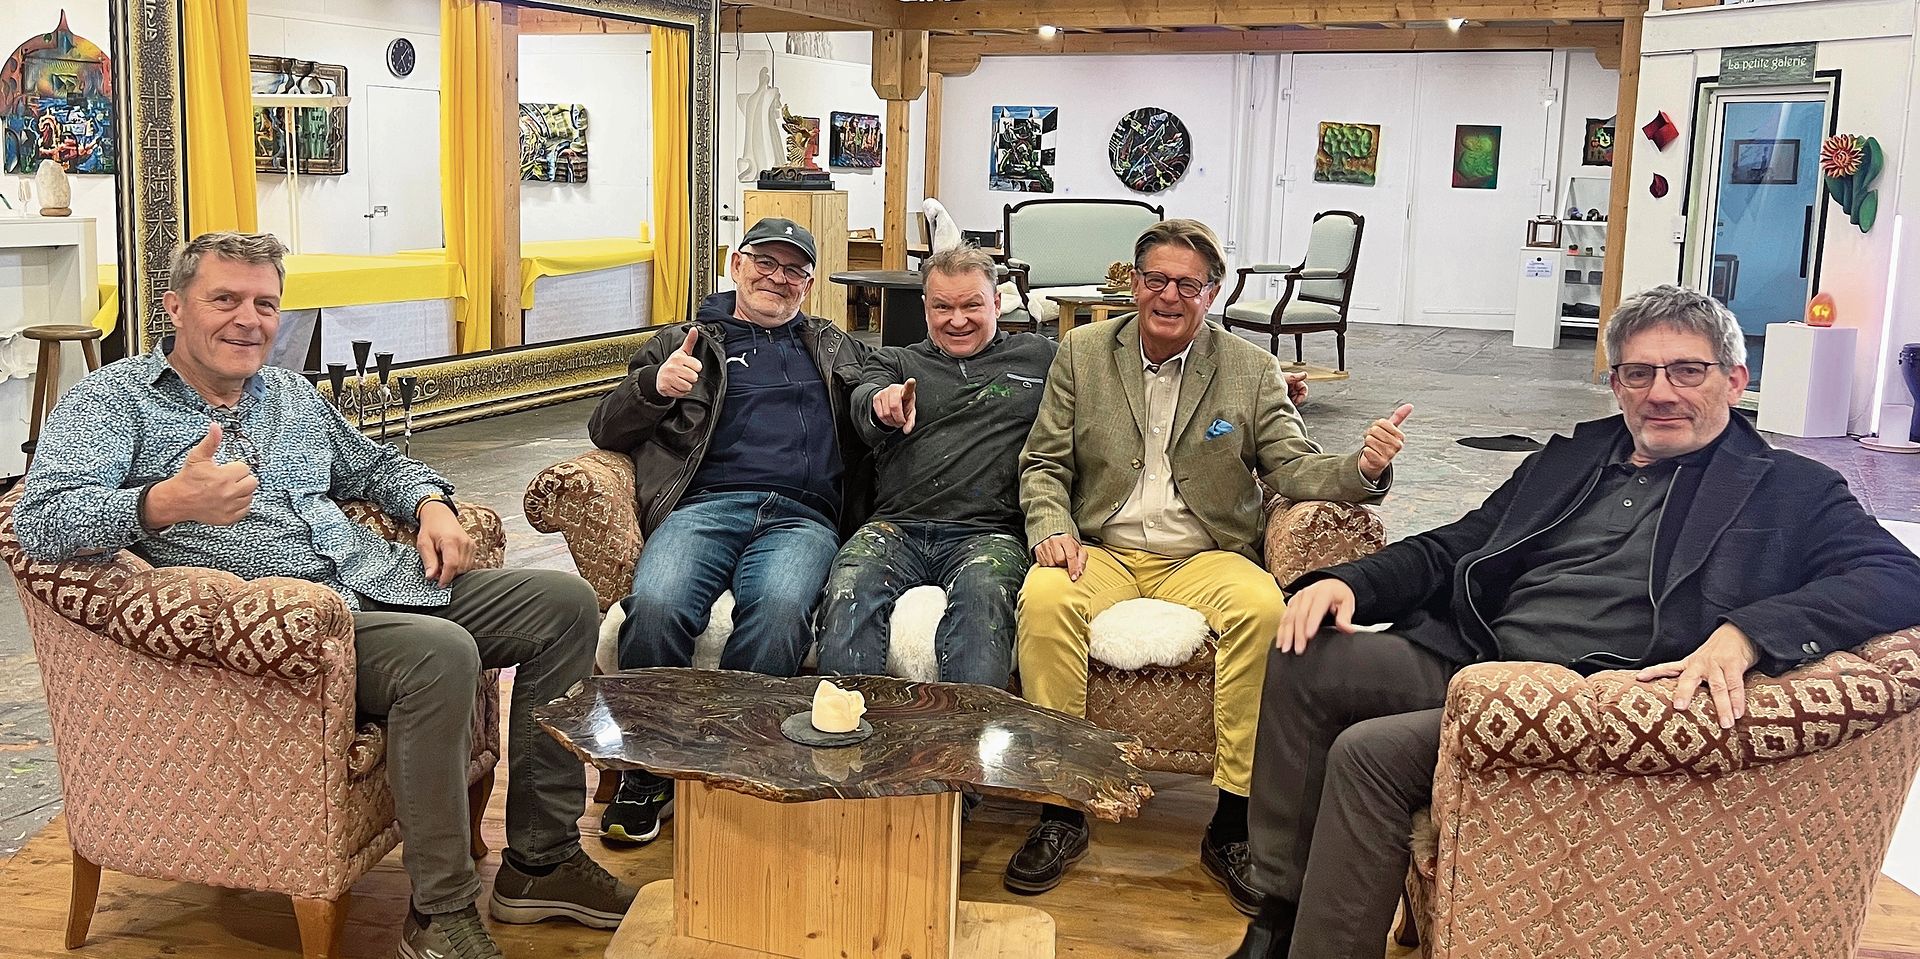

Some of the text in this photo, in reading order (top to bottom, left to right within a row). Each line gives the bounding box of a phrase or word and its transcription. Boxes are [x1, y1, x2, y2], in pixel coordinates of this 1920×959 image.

[1727, 55, 1807, 71] La petite galerie
